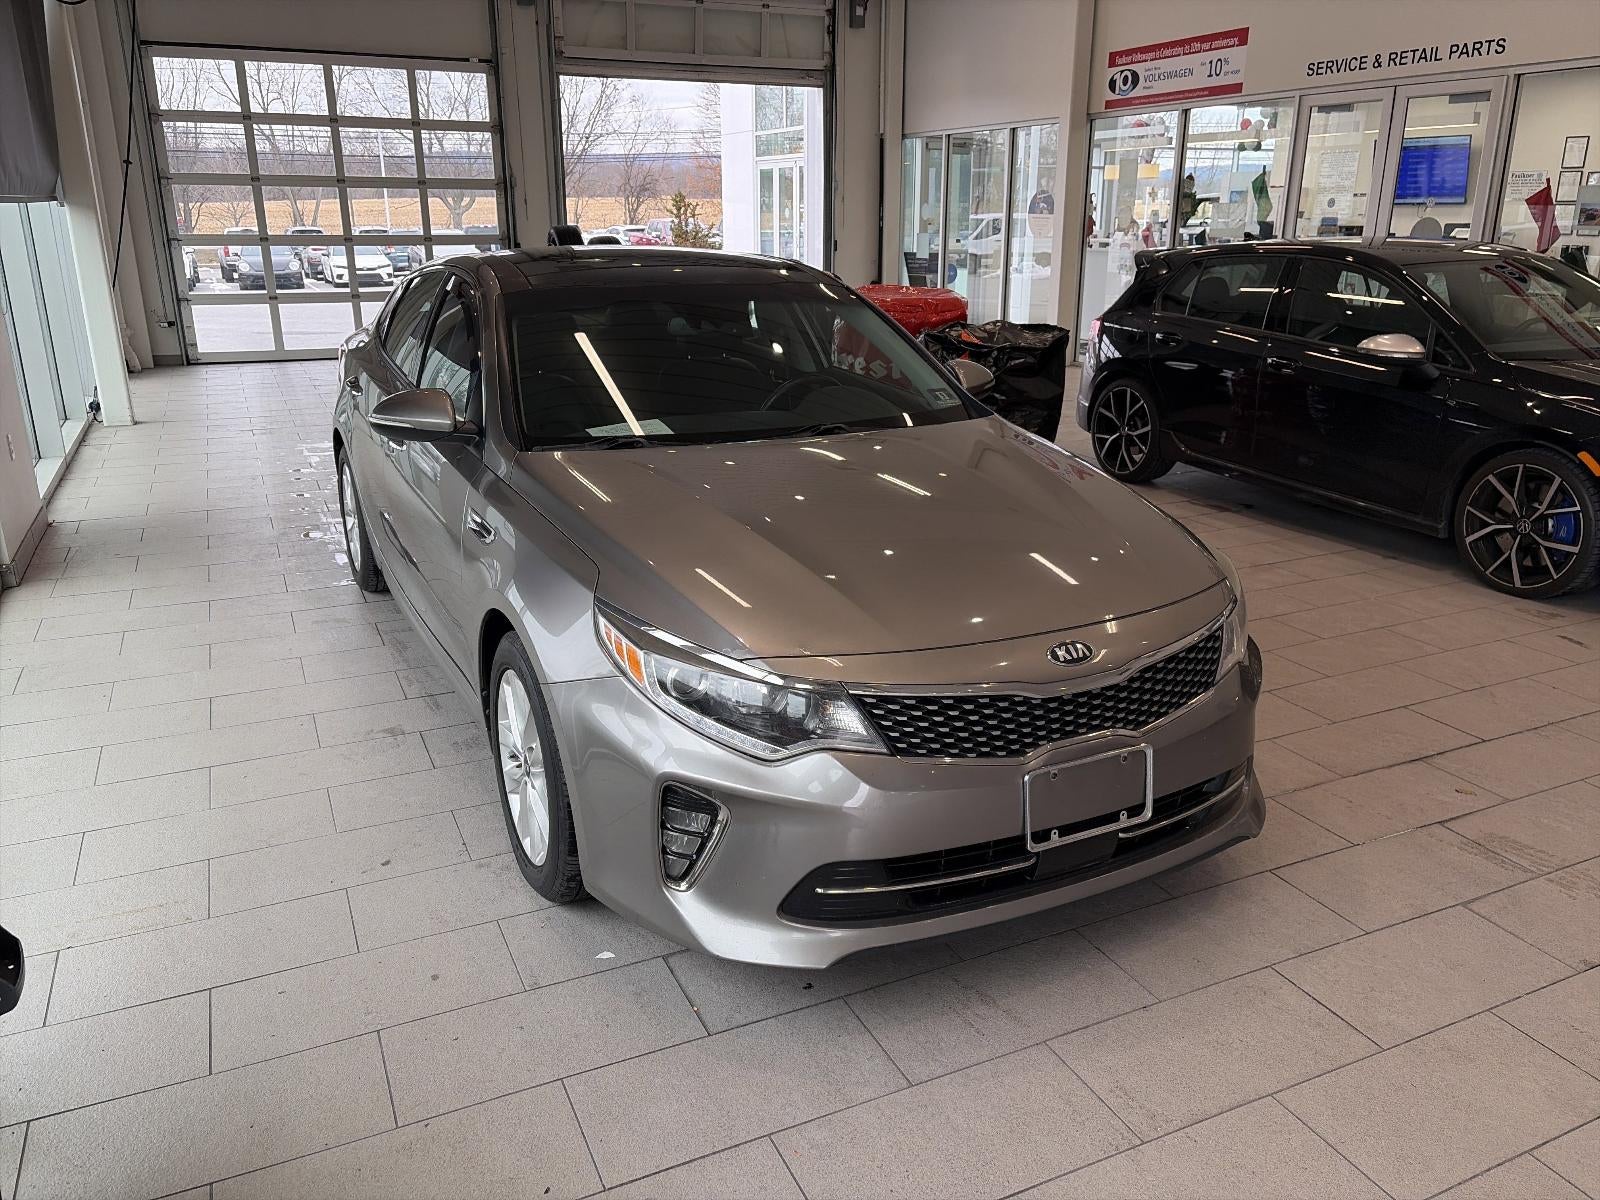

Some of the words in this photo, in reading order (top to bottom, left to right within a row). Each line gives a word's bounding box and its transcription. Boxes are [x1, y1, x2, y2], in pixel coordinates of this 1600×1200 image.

[1306, 55, 1368, 77] SERVICE
[1372, 53, 1382, 69] &
[1387, 46, 1443, 67] RETAIL
[1448, 37, 1507, 60] PARTS
[1143, 67, 1194, 83] VOLKSWAGEN
[1053, 643, 1091, 662] KIA
